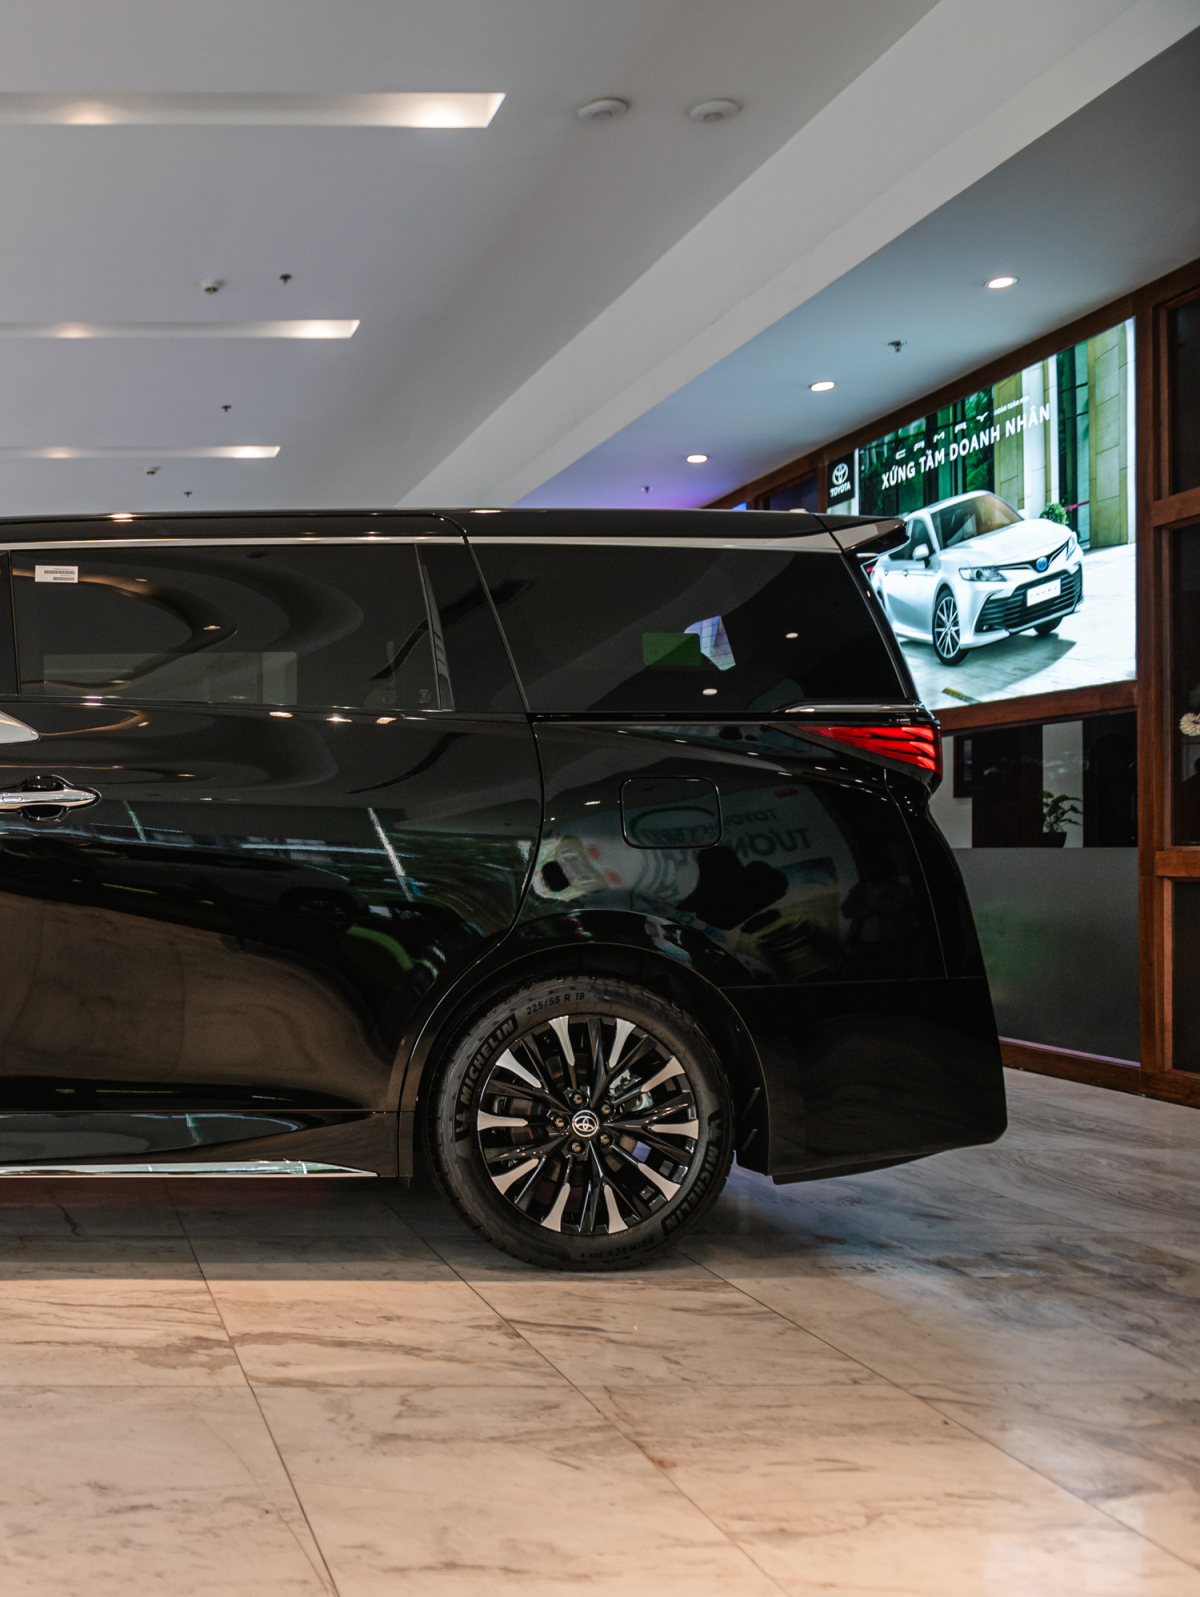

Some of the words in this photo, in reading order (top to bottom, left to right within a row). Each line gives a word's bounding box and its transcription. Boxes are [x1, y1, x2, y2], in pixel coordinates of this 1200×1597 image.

[881, 465, 915, 490] XỨNG
[919, 451, 945, 473] TẦM
[949, 424, 1001, 461] DOANH
[1005, 403, 1050, 438] NHÂN
[830, 482, 851, 498] TOYOTA
[526, 995, 561, 1015] 225/55
[564, 993, 571, 1002] R
[575, 992, 585, 1001] 19
[460, 1019, 515, 1106] MICHELIN
[665, 1145, 719, 1230] MICHELIN
[608, 1235, 654, 1257] PRIMACY
